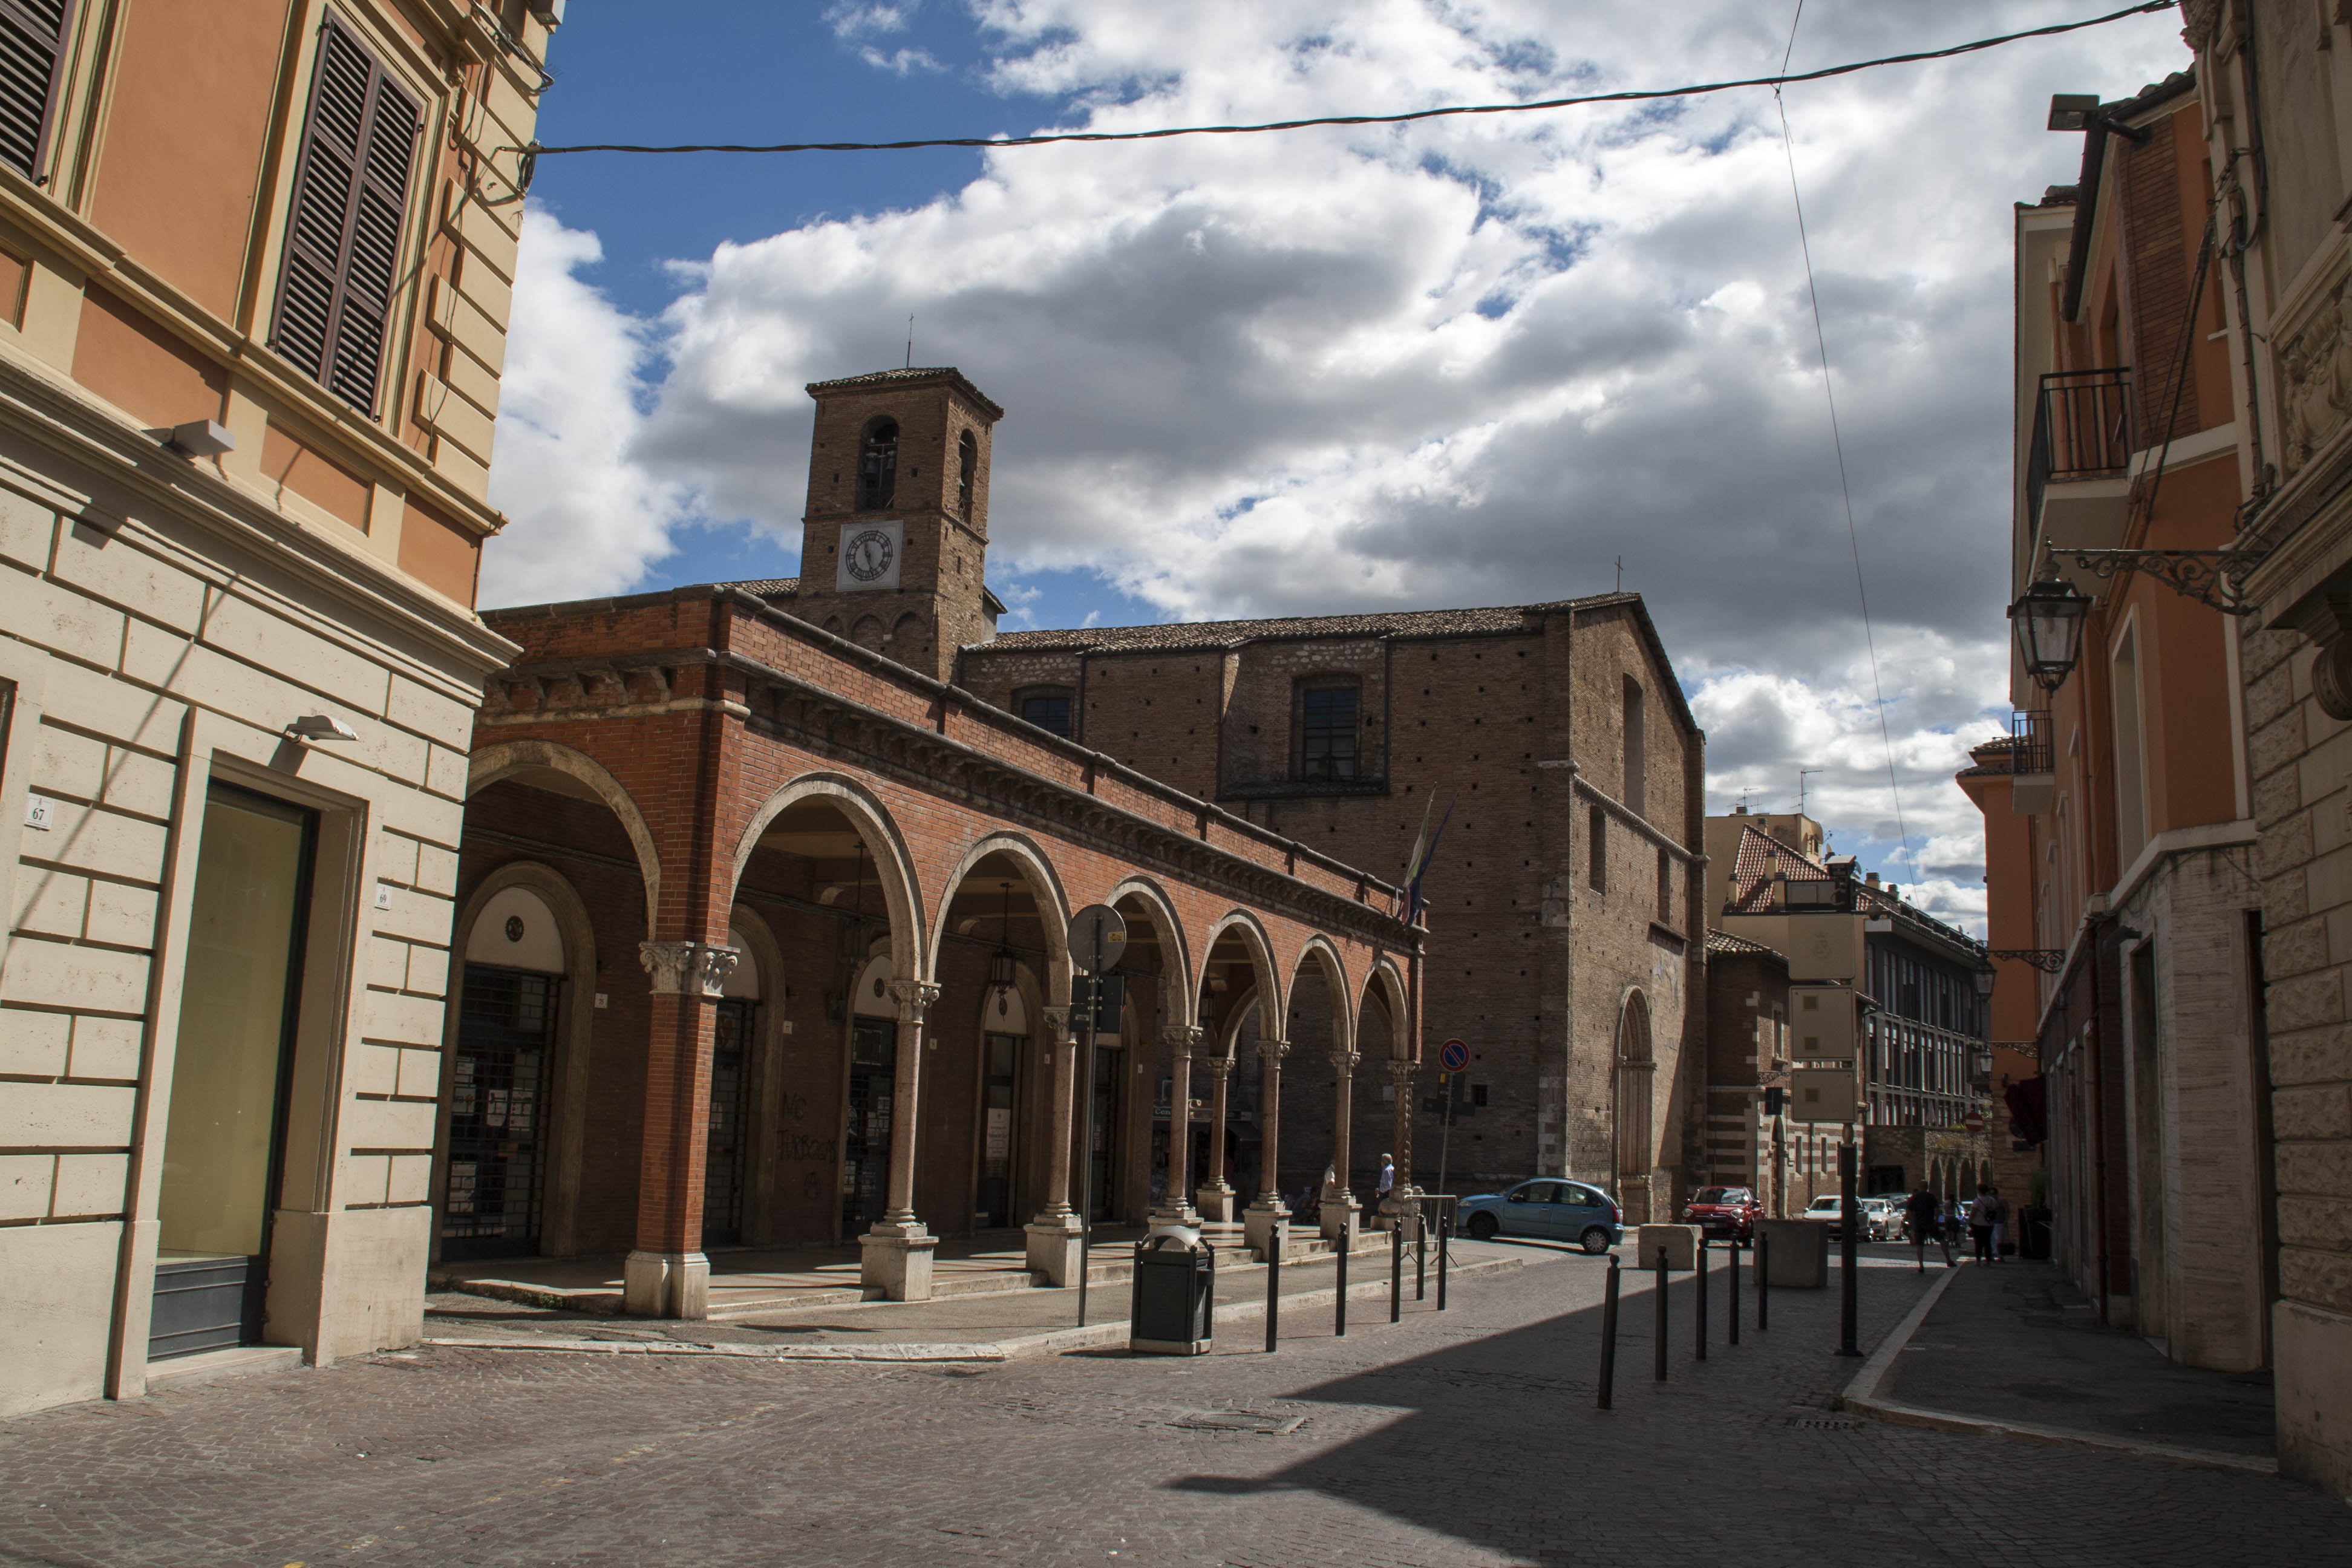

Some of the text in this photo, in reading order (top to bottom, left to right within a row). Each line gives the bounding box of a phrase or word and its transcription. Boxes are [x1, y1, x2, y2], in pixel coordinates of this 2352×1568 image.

[33, 808, 45, 820] 67
[379, 894, 387, 906] 69
[781, 1091, 808, 1120] NO
